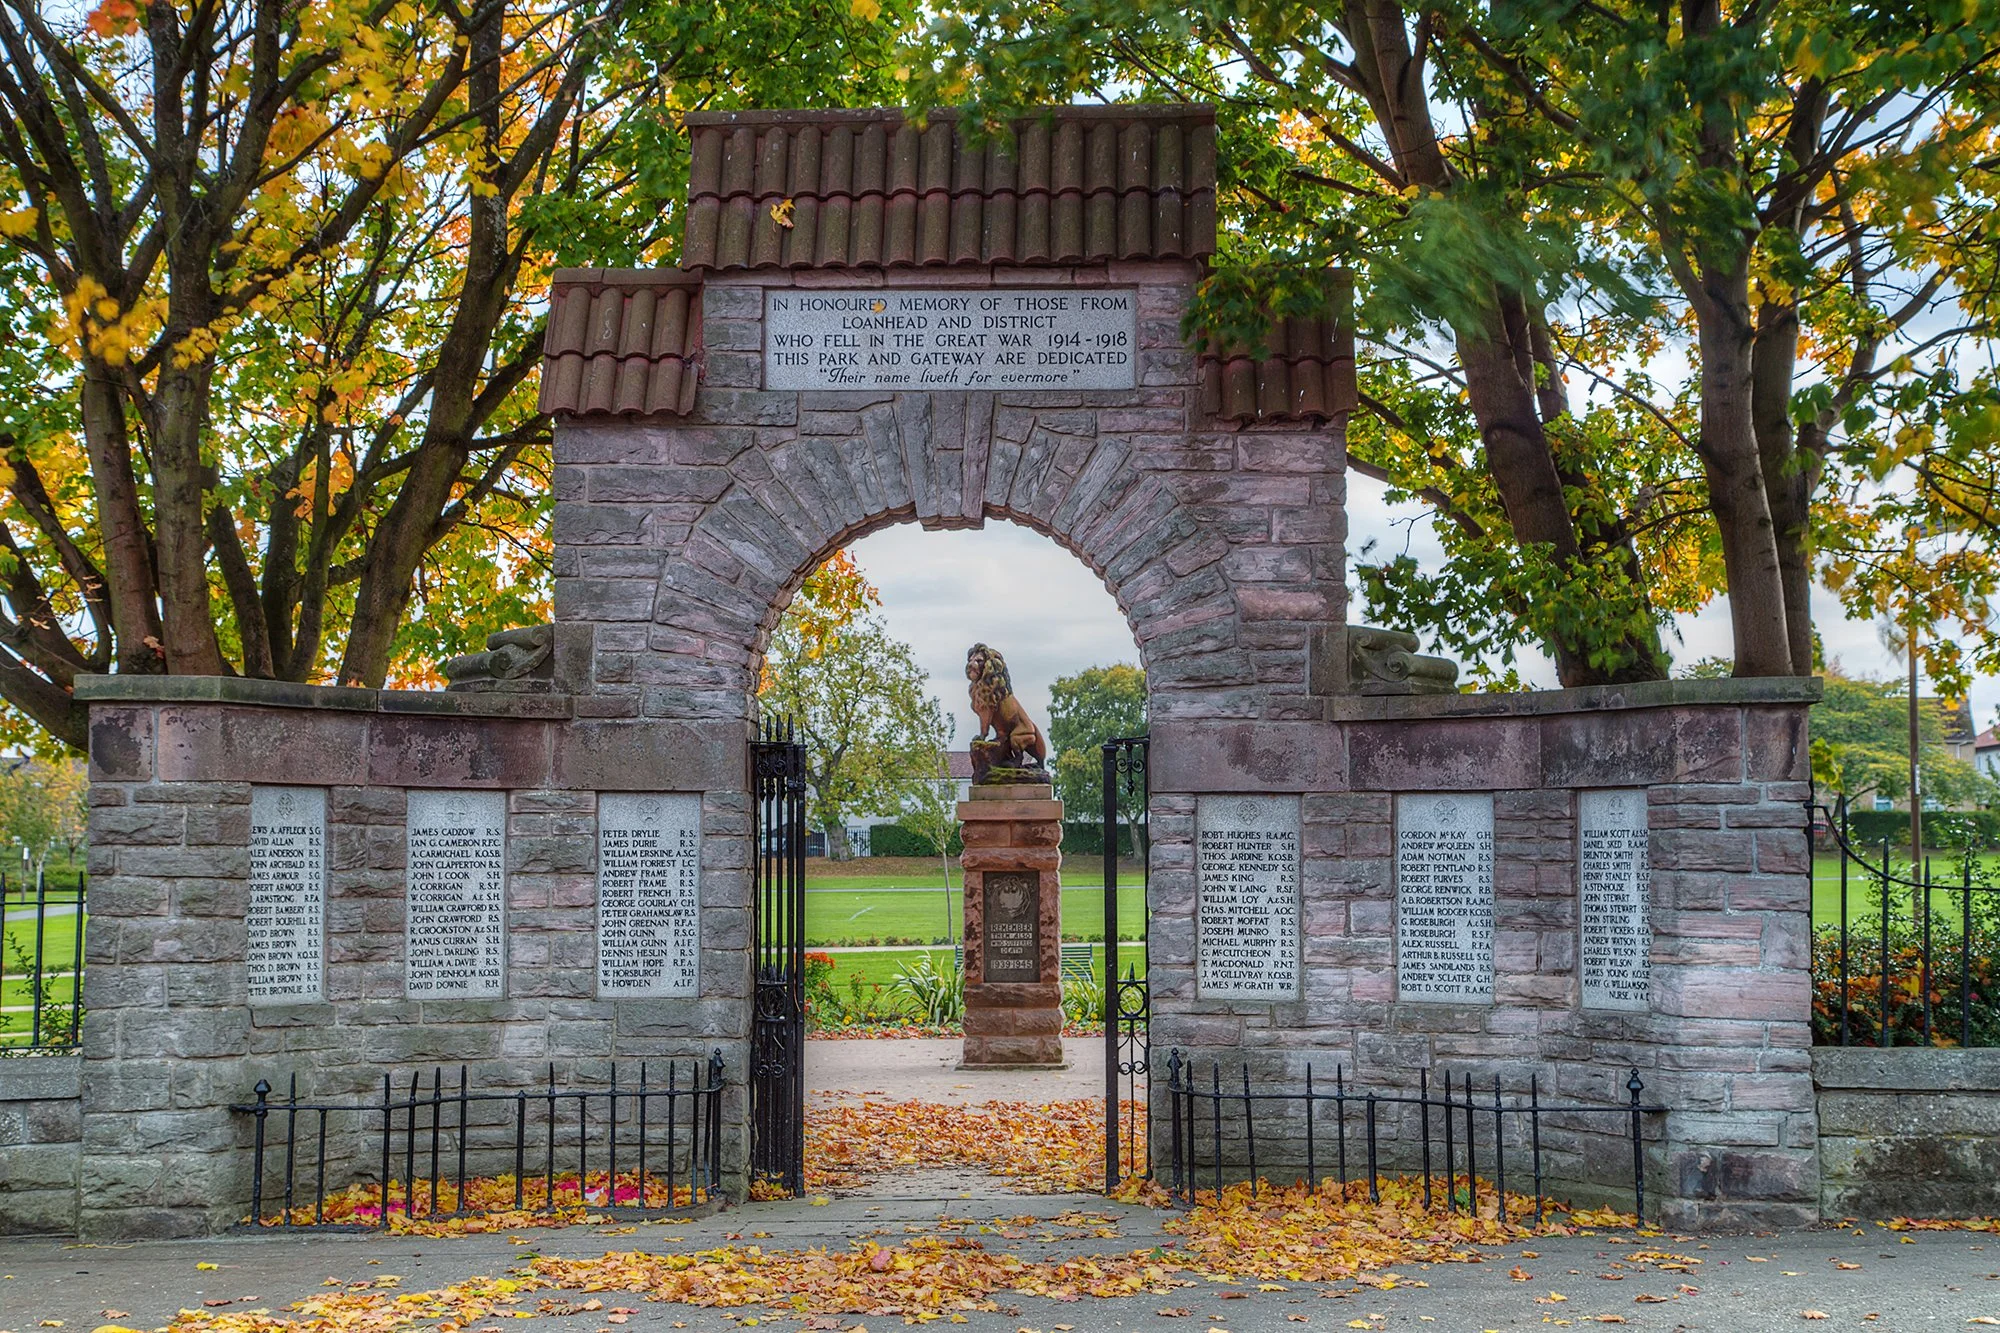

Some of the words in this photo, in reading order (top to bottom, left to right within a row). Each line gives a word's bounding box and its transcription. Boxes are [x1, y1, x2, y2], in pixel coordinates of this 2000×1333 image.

[774, 298, 788, 311] IN
[801, 298, 887, 311] HONOURED
[900, 298, 970, 311] MEMORY
[980, 298, 1001, 311] OF
[1014, 298, 1073, 311] THOSE
[1082, 298, 1127, 311] FROM
[843, 316, 928, 329] LOANHEAD
[938, 316, 971, 329] AND
[984, 316, 1056, 329] DISTRICT
[774, 334, 813, 347] WHO
[824, 334, 860, 347] FELL
[870, 334, 884, 347] IN
[894, 334, 924, 347] THE
[936, 334, 986, 347] GREAT
[998, 334, 1032, 347] WAR
[774, 352, 809, 365] THIS
[818, 352, 858, 365] PARK
[868, 352, 900, 365] AND
[911, 352, 984, 365] GATEWAY
[994, 352, 1026, 365] ARE
[1038, 352, 1127, 365] DEDICATED
[875, 374, 910, 383] name
[920, 368, 958, 383] liveth
[966, 368, 992, 386] for
[1227, 831, 1261, 839] HUGHES
[1401, 831, 1436, 839] GORDON
[1584, 841, 1604, 849] DANIEL
[1584, 851, 1612, 859] BRUNTON
[1614, 851, 1633, 859] SMITH
[1401, 875, 1430, 883] ROBERT
[1584, 872, 1603, 880] HENRY
[1401, 885, 1432, 893] GEORGE
[1435, 886, 1472, 894] RENWICK
[1590, 883, 1624, 891] STENHOUSE
[255, 894, 294, 903] ARMSTRONG
[1416, 897, 1462, 905] ROBERTSON
[276, 906, 305, 914] BAMBERY
[1437, 908, 1468, 916] RODGER
[1584, 904, 1607, 912] THOMAS
[1610, 905, 1637, 913] STEWART
[248, 918, 272, 926] ROBERT
[276, 917, 306, 926] BOURHILL
[1603, 916, 1630, 924] STIRLING
[419, 926, 471, 934] CROOKSTON
[991, 924, 1032, 932] REMEMBER
[1610, 926, 1634, 934] VICKERS
[1410, 930, 1455, 938] ROSEBURGH
[248, 941, 269, 949] JAMES
[272, 940, 296, 949] BROWN
[410, 938, 440, 946] MANUS
[443, 937, 477, 945] CURRAN
[1426, 941, 1459, 949] RUSSELL
[1611, 937, 1636, 945] WATSON
[445, 948, 479, 956] DARLING
[248, 952, 265, 961] JOHN
[268, 952, 292, 960] BROWN
[1430, 963, 1475, 971] SANDILANDS
[1609, 959, 1632, 967] WILSON
[437, 970, 476, 978] DENHOLM
[1438, 974, 1472, 982] SCLATER
[436, 981, 468, 989] DOWNIE
[1434, 984, 1461, 993] SCOTT
[270, 986, 302, 995] BROWNLIE
